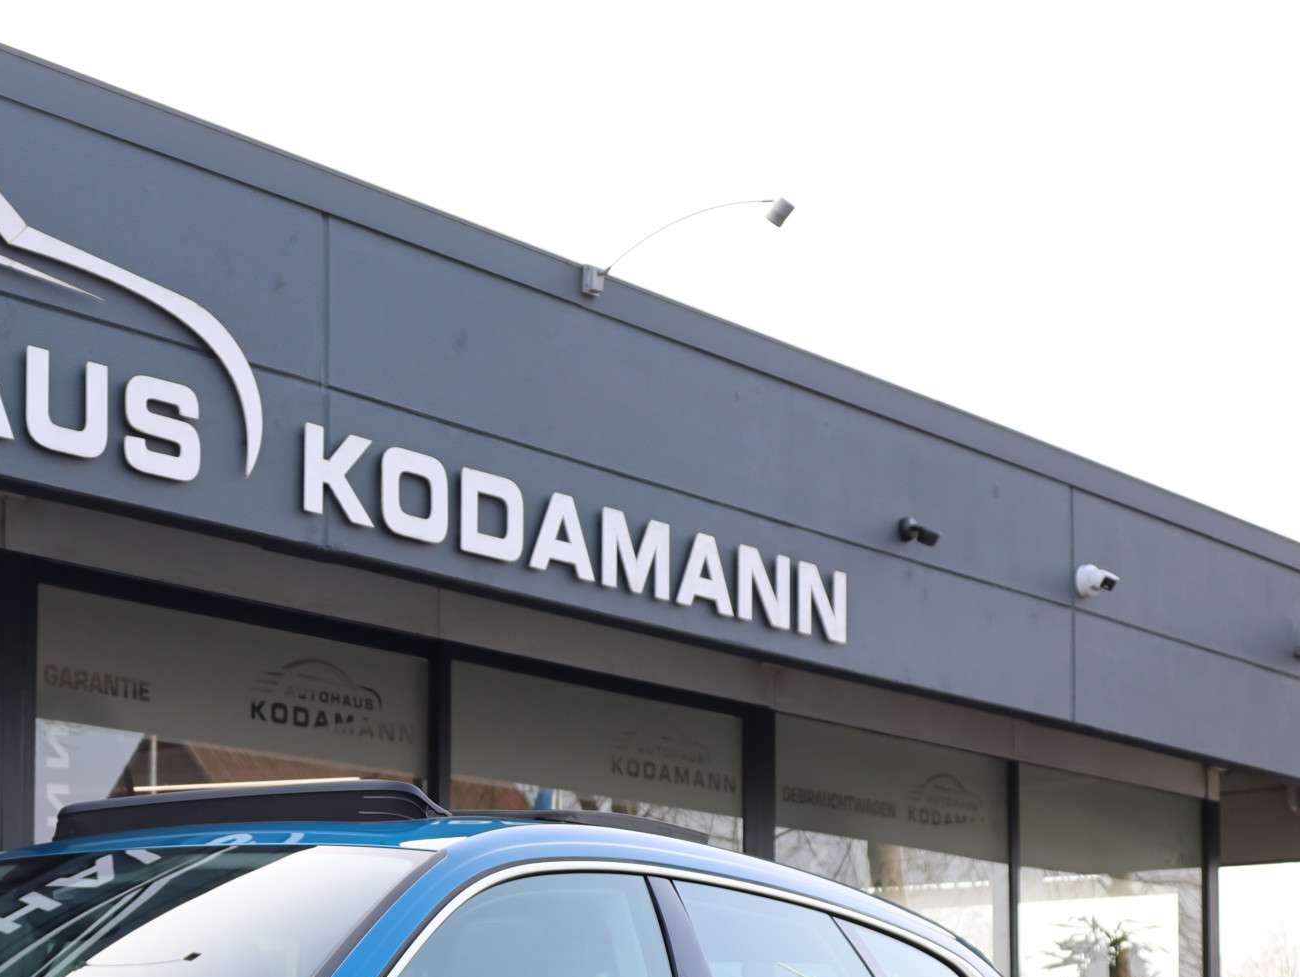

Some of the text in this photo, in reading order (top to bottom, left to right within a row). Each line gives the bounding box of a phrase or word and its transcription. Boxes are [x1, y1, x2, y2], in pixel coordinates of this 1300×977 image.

[303, 422, 848, 644] KODAMANN
[43, 663, 151, 703] GARANTIE
[610, 754, 737, 793] KODAMANN
